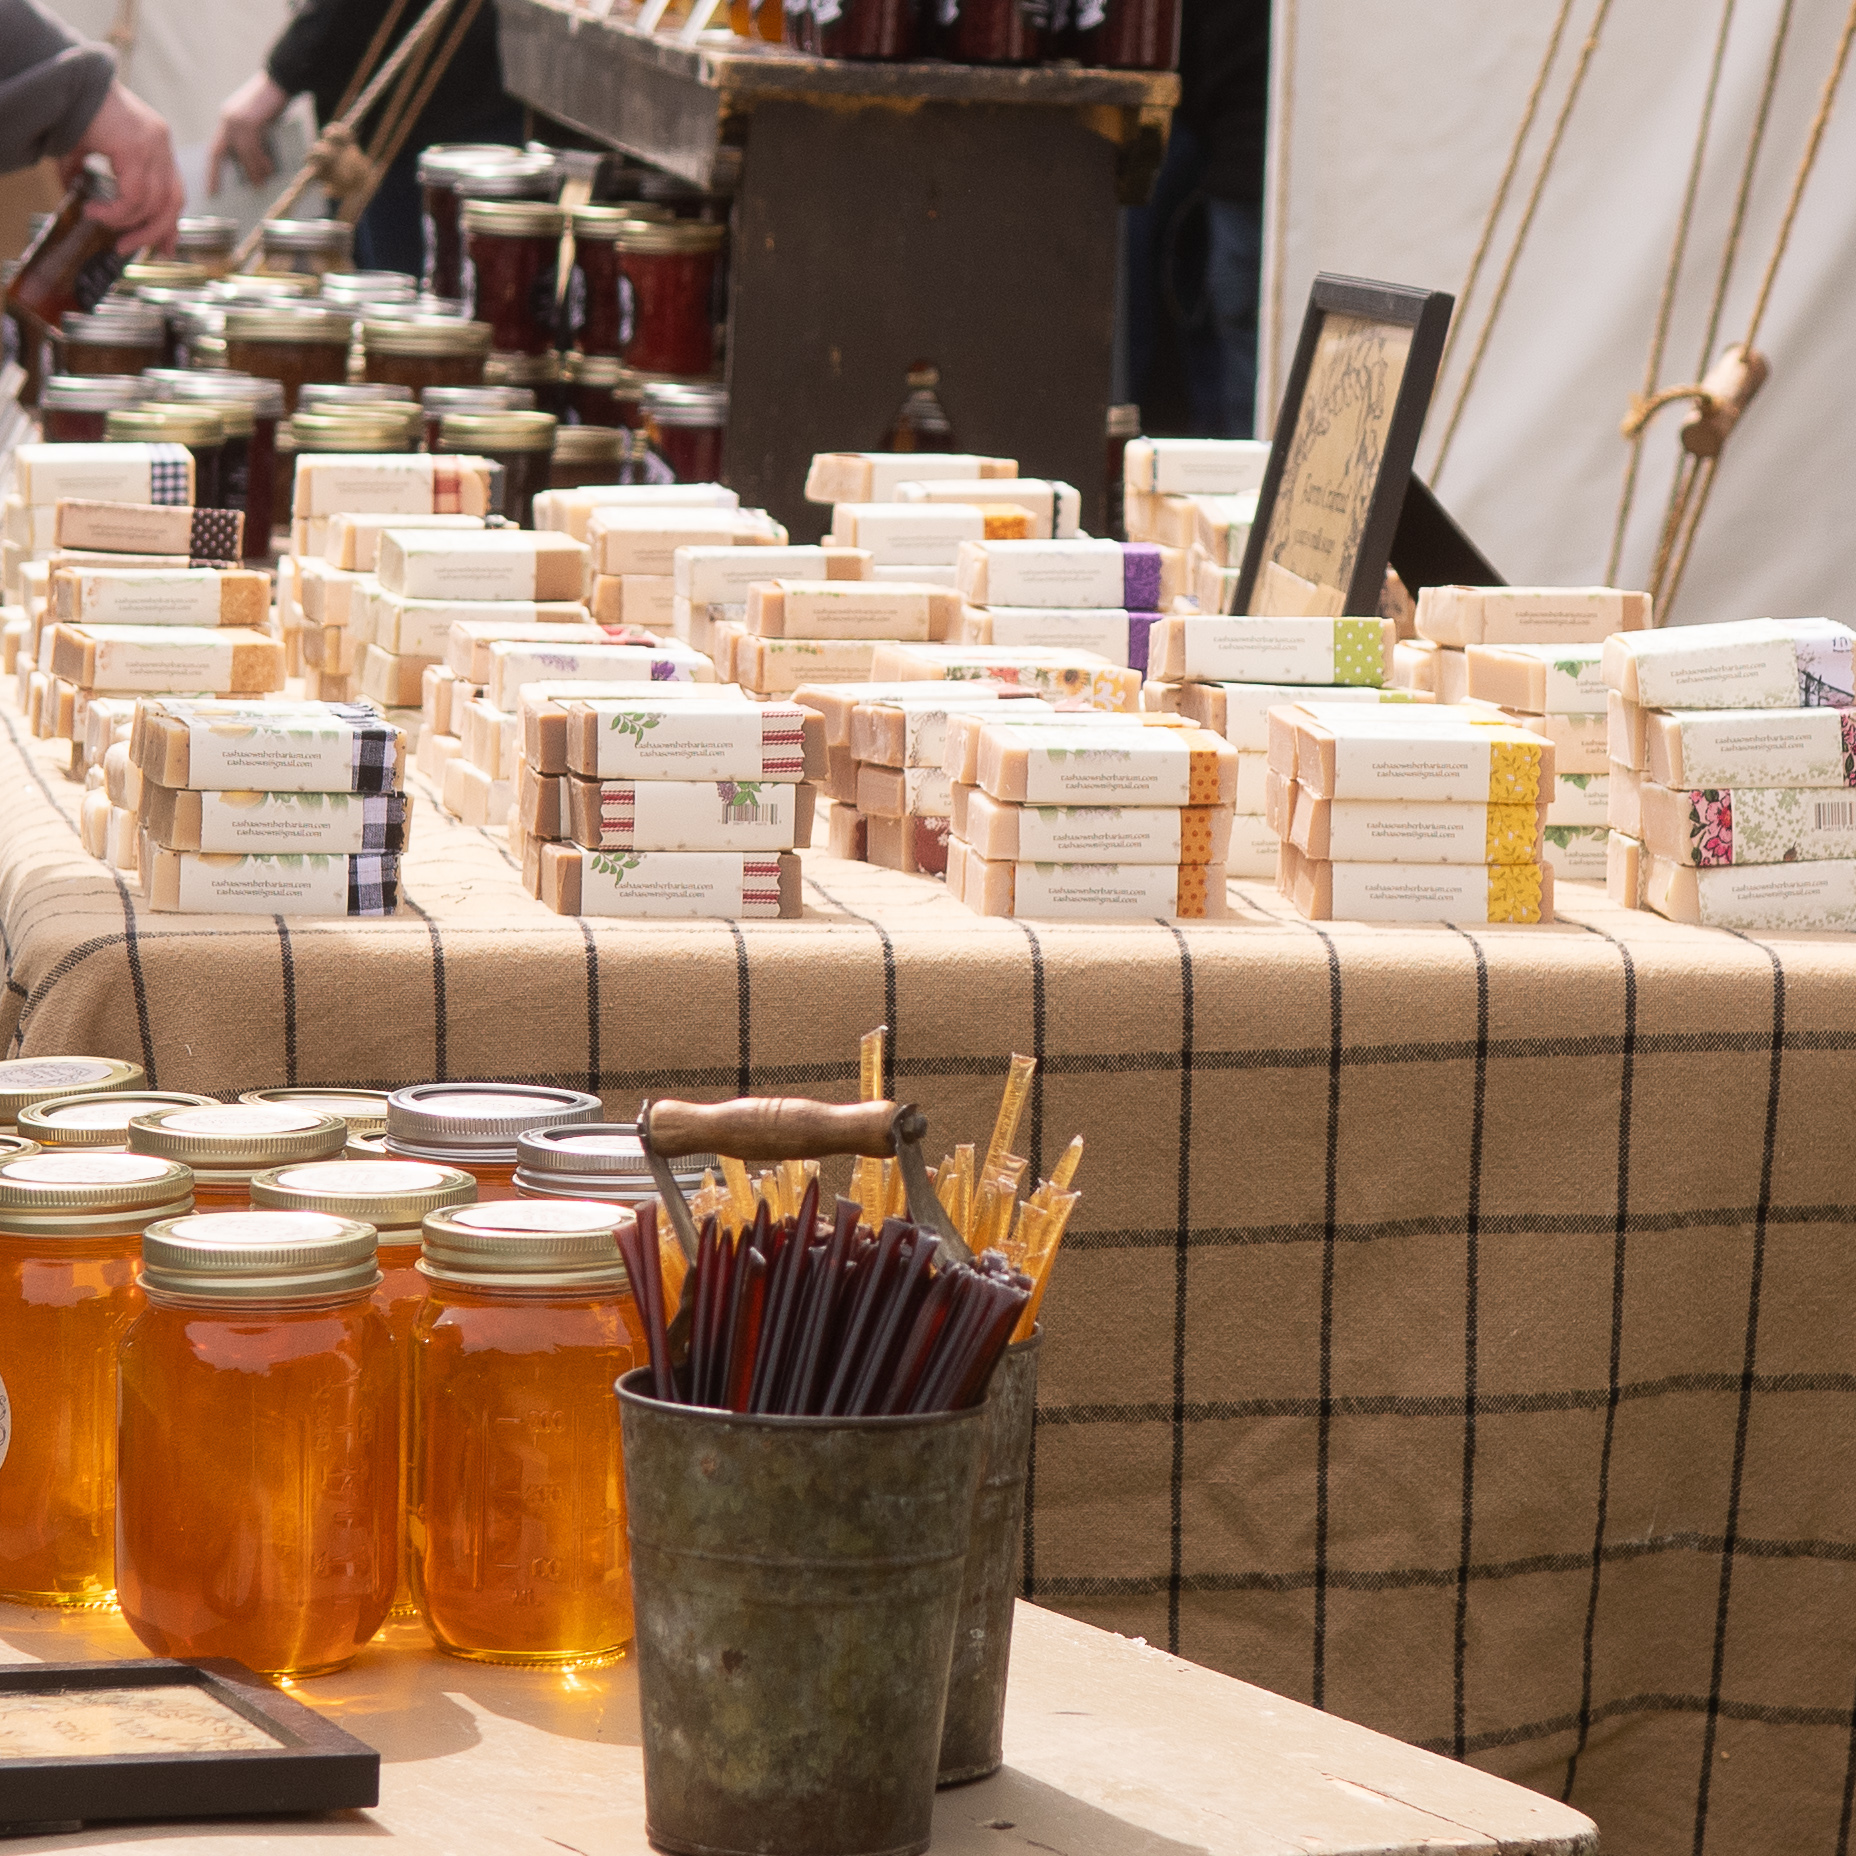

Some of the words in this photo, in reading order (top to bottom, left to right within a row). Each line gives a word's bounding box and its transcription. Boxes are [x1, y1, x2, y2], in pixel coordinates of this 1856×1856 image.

[634, 739, 734, 749] tashasownherbarium.com
[222, 749, 322, 760] tashasownherbarium.com
[639, 748, 725, 759] tashasown@gmail.com
[226, 758, 313, 769] tashasown@gmail.com
[1372, 761, 1469, 770] tashasownherbarium.com
[1060, 773, 1158, 782] tashasownherbarium.com
[1376, 769, 1460, 779] tashasown@gmail.com
[1065, 780, 1150, 792] tashasown@gmail.com
[231, 819, 331, 830] tashasownherbarium.com
[1366, 820, 1464, 830] tashasownherbarium.com
[236, 828, 322, 839] tashasown@gmail.com
[1052, 832, 1151, 841] tashasownherbarium.com
[1371, 829, 1455, 841] tashasown@gmail.com
[1057, 839, 1142, 851] tashasown@gmail.com
[211, 879, 312, 889] tashasownherbarium.com
[614, 881, 714, 891] tashasownherbarium.com
[1365, 883, 1463, 893] tashasownherbarium.com
[216, 887, 303, 898] tashasown@gmail.com
[619, 889, 705, 900] tashasown@gmail.com
[1048, 887, 1146, 896] tashasownherbarium.com
[1369, 891, 1454, 902] tashasown@gmail.com
[1053, 894, 1138, 905] tashasown@gmail.com
